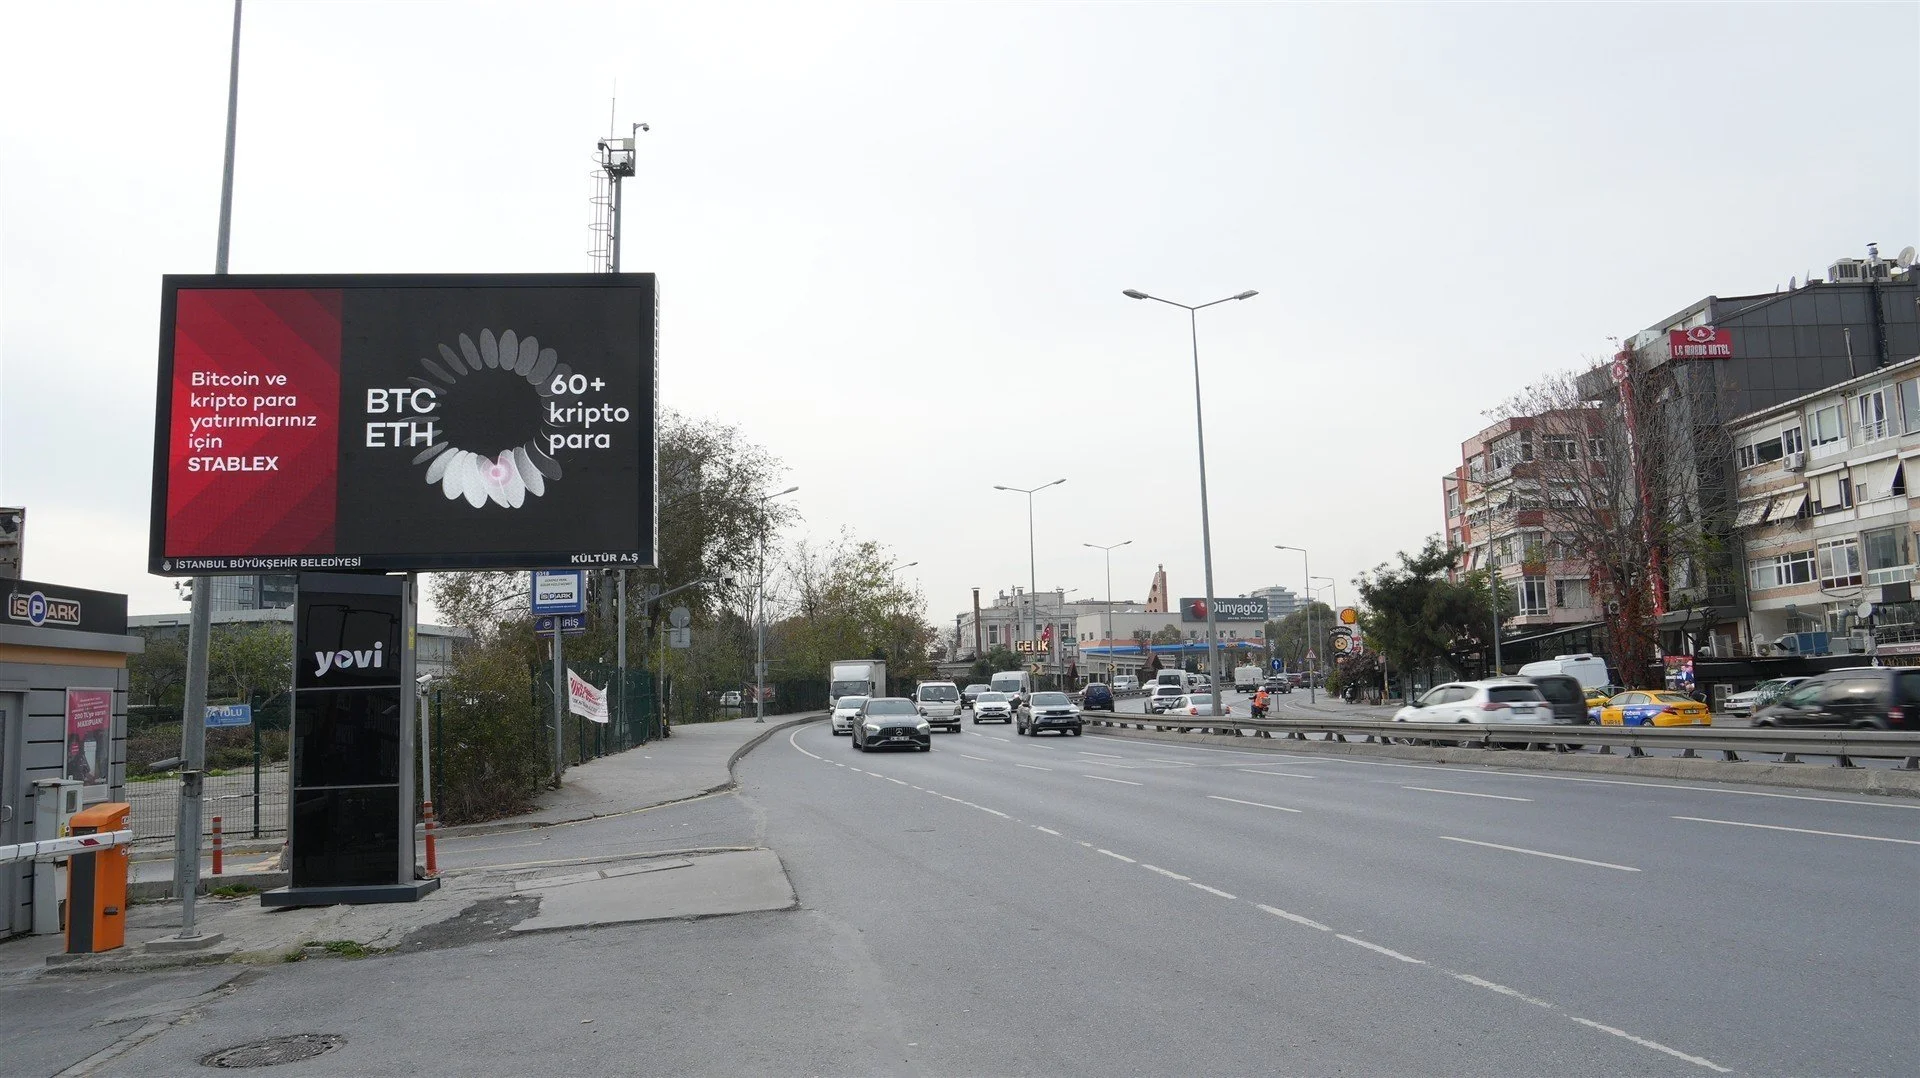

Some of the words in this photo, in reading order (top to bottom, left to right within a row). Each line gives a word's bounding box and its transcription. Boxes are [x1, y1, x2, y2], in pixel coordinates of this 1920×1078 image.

[191, 371, 260, 386] Bitcoin
[265, 374, 287, 386] ve
[550, 374, 606, 395] 60+
[190, 392, 248, 411] kripto
[253, 395, 297, 411] para
[366, 388, 437, 414] BTC
[189, 412, 317, 432] yatırımlarınız
[550, 401, 630, 429] kripto
[188, 433, 223, 452] için
[365, 422, 433, 448] ETH
[550, 433, 611, 455] para
[187, 456, 279, 472] STABLEX
[176, 559, 227, 569] İSTANBUL
[229, 557, 298, 569] BÜYÜKŞEHİR
[300, 556, 361, 567] BELEDİYESİ
[571, 553, 617, 563] KÜLTÜR
[620, 553, 639, 563] A.Ş
[1213, 601, 1264, 615] Dünyagöz
[562, 618, 579, 628] İRİŞ
[314, 641, 383, 677] yovi
